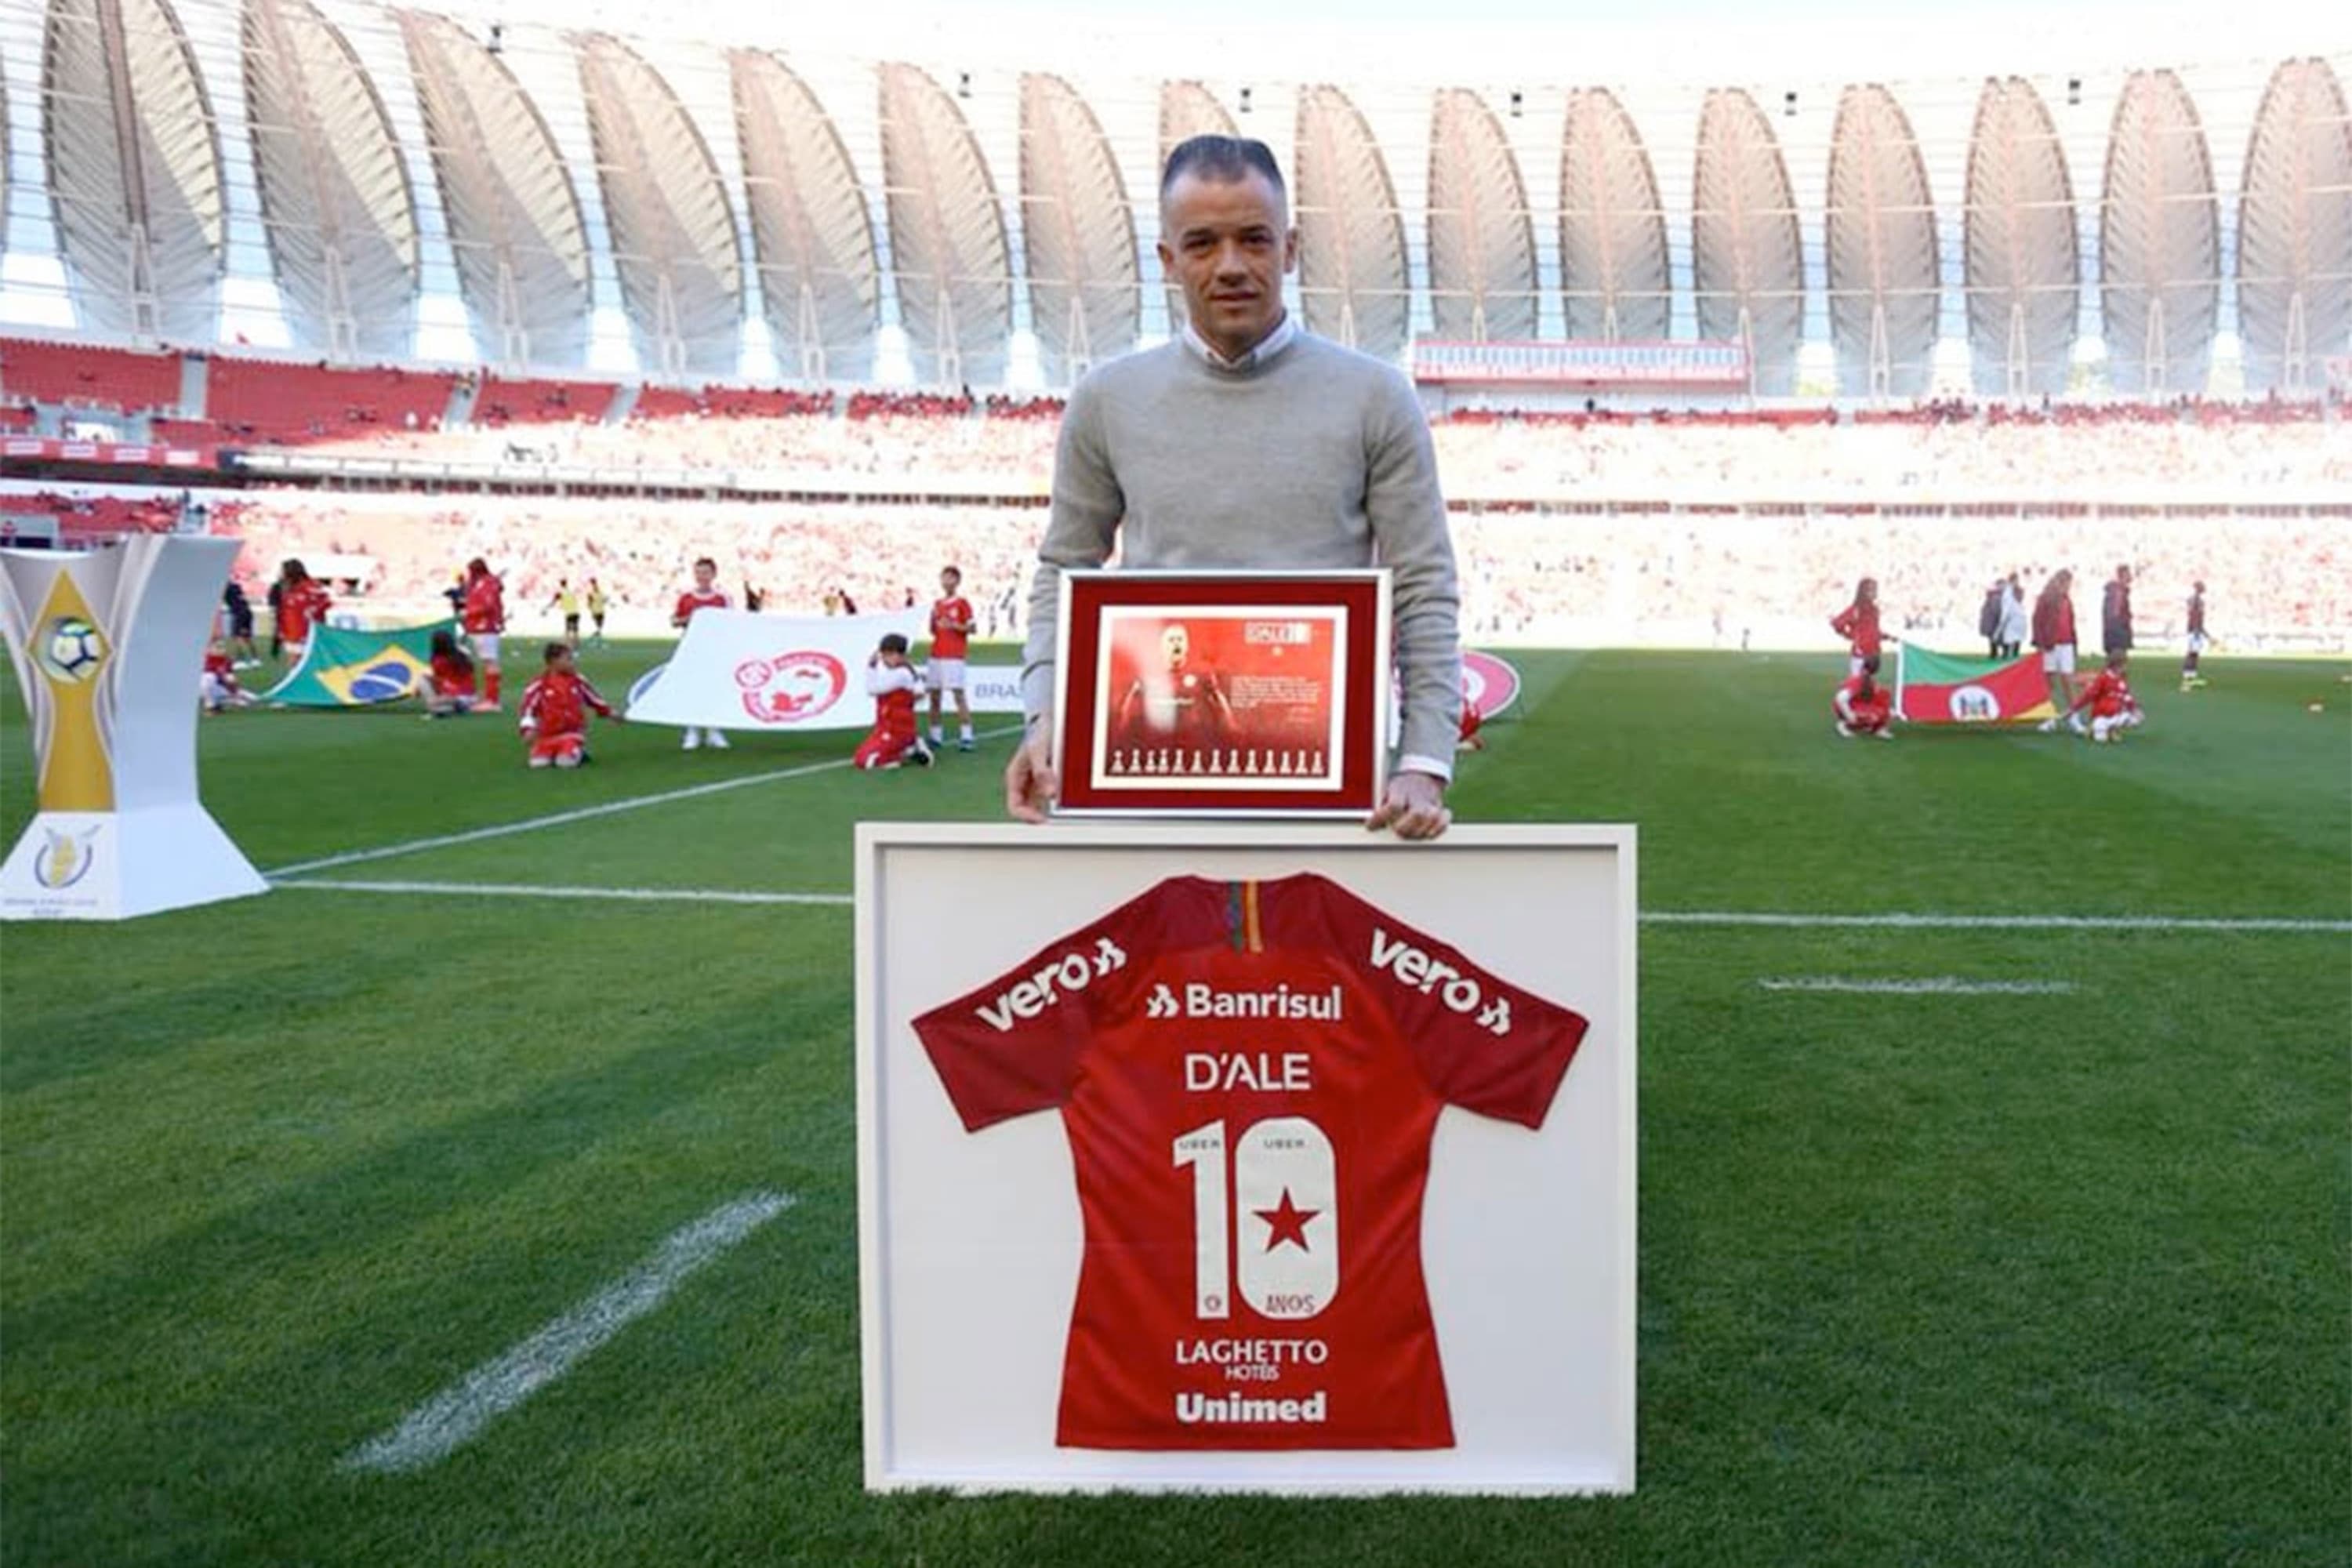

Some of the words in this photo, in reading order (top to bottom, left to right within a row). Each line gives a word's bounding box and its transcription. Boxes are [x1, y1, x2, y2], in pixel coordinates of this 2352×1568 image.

[975, 684, 1018, 699] BRA
[1370, 927, 1481, 1012] vero
[975, 953, 1091, 1032] vero
[1185, 983, 1342, 1019] Banrisul
[1185, 1052, 1312, 1091] D'ALE
[1264, 1139, 1305, 1149] UBER
[1173, 1116, 1339, 1320] 10
[1176, 1339, 1328, 1364] LAGHETTO
[1176, 1391, 1327, 1422] Unimed
